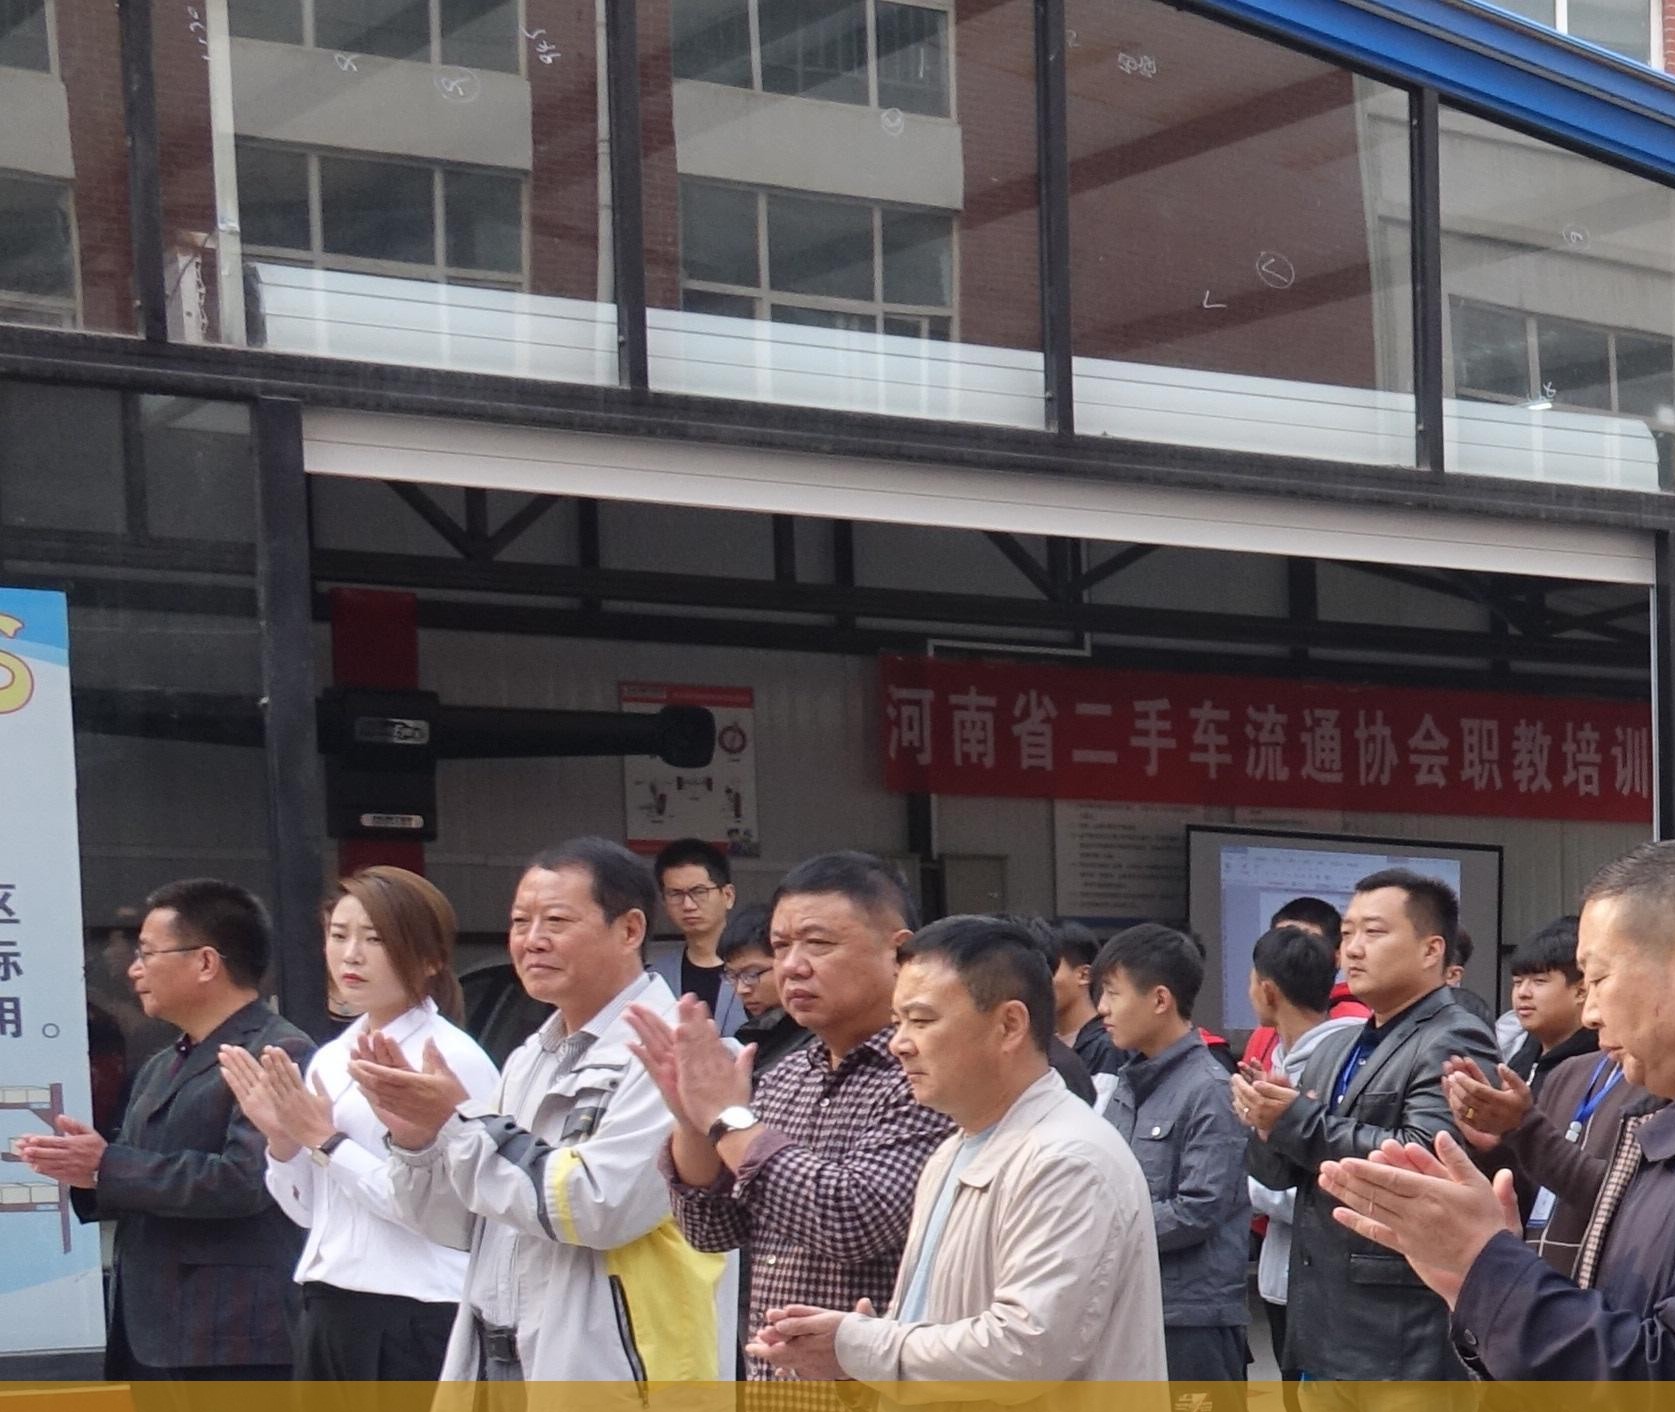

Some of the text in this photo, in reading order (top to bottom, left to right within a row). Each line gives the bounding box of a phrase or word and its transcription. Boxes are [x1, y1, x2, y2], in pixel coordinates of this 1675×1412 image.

[886, 682, 1650, 802] 河南省二手车流通协会职教培训
